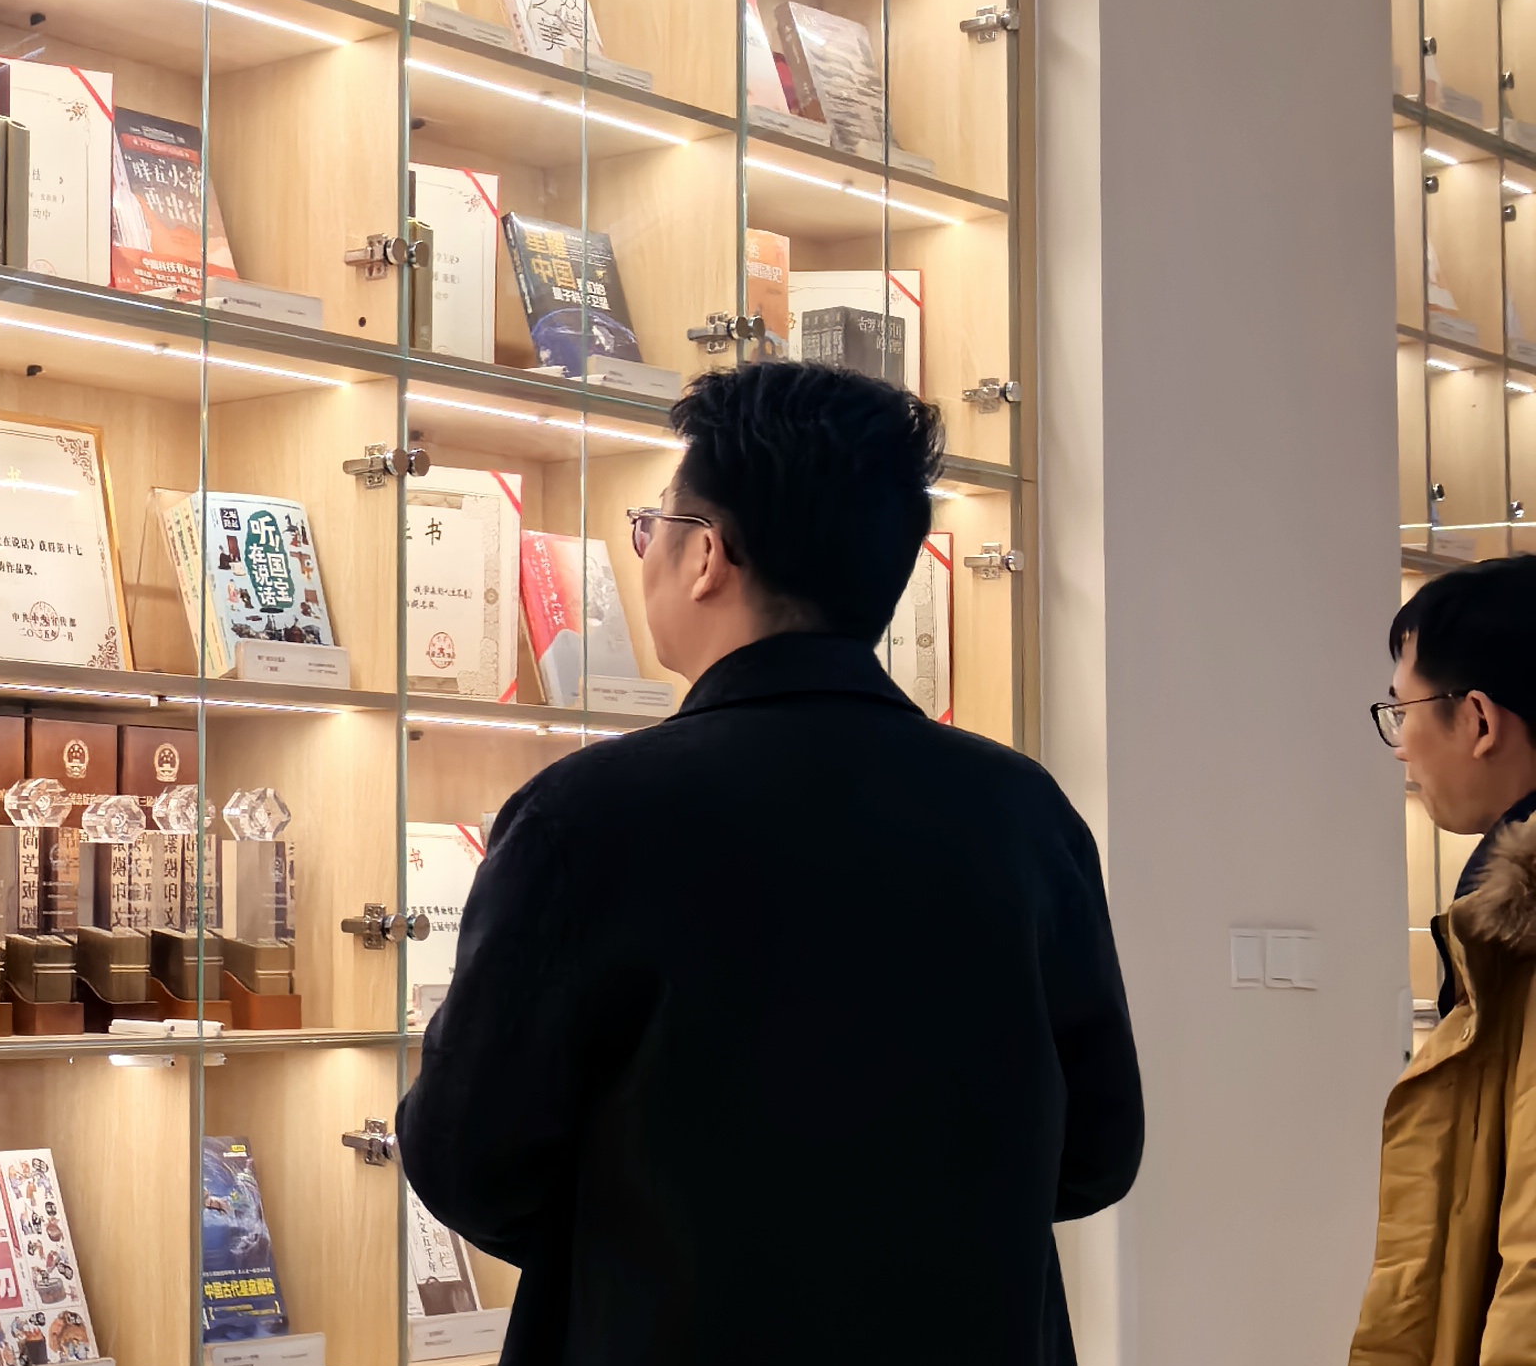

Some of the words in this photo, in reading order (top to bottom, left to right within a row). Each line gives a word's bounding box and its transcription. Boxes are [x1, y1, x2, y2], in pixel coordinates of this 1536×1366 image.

[247, 543, 277, 607] 在说话
[268, 552, 294, 604] 国宝
[409, 848, 424, 871] 书
